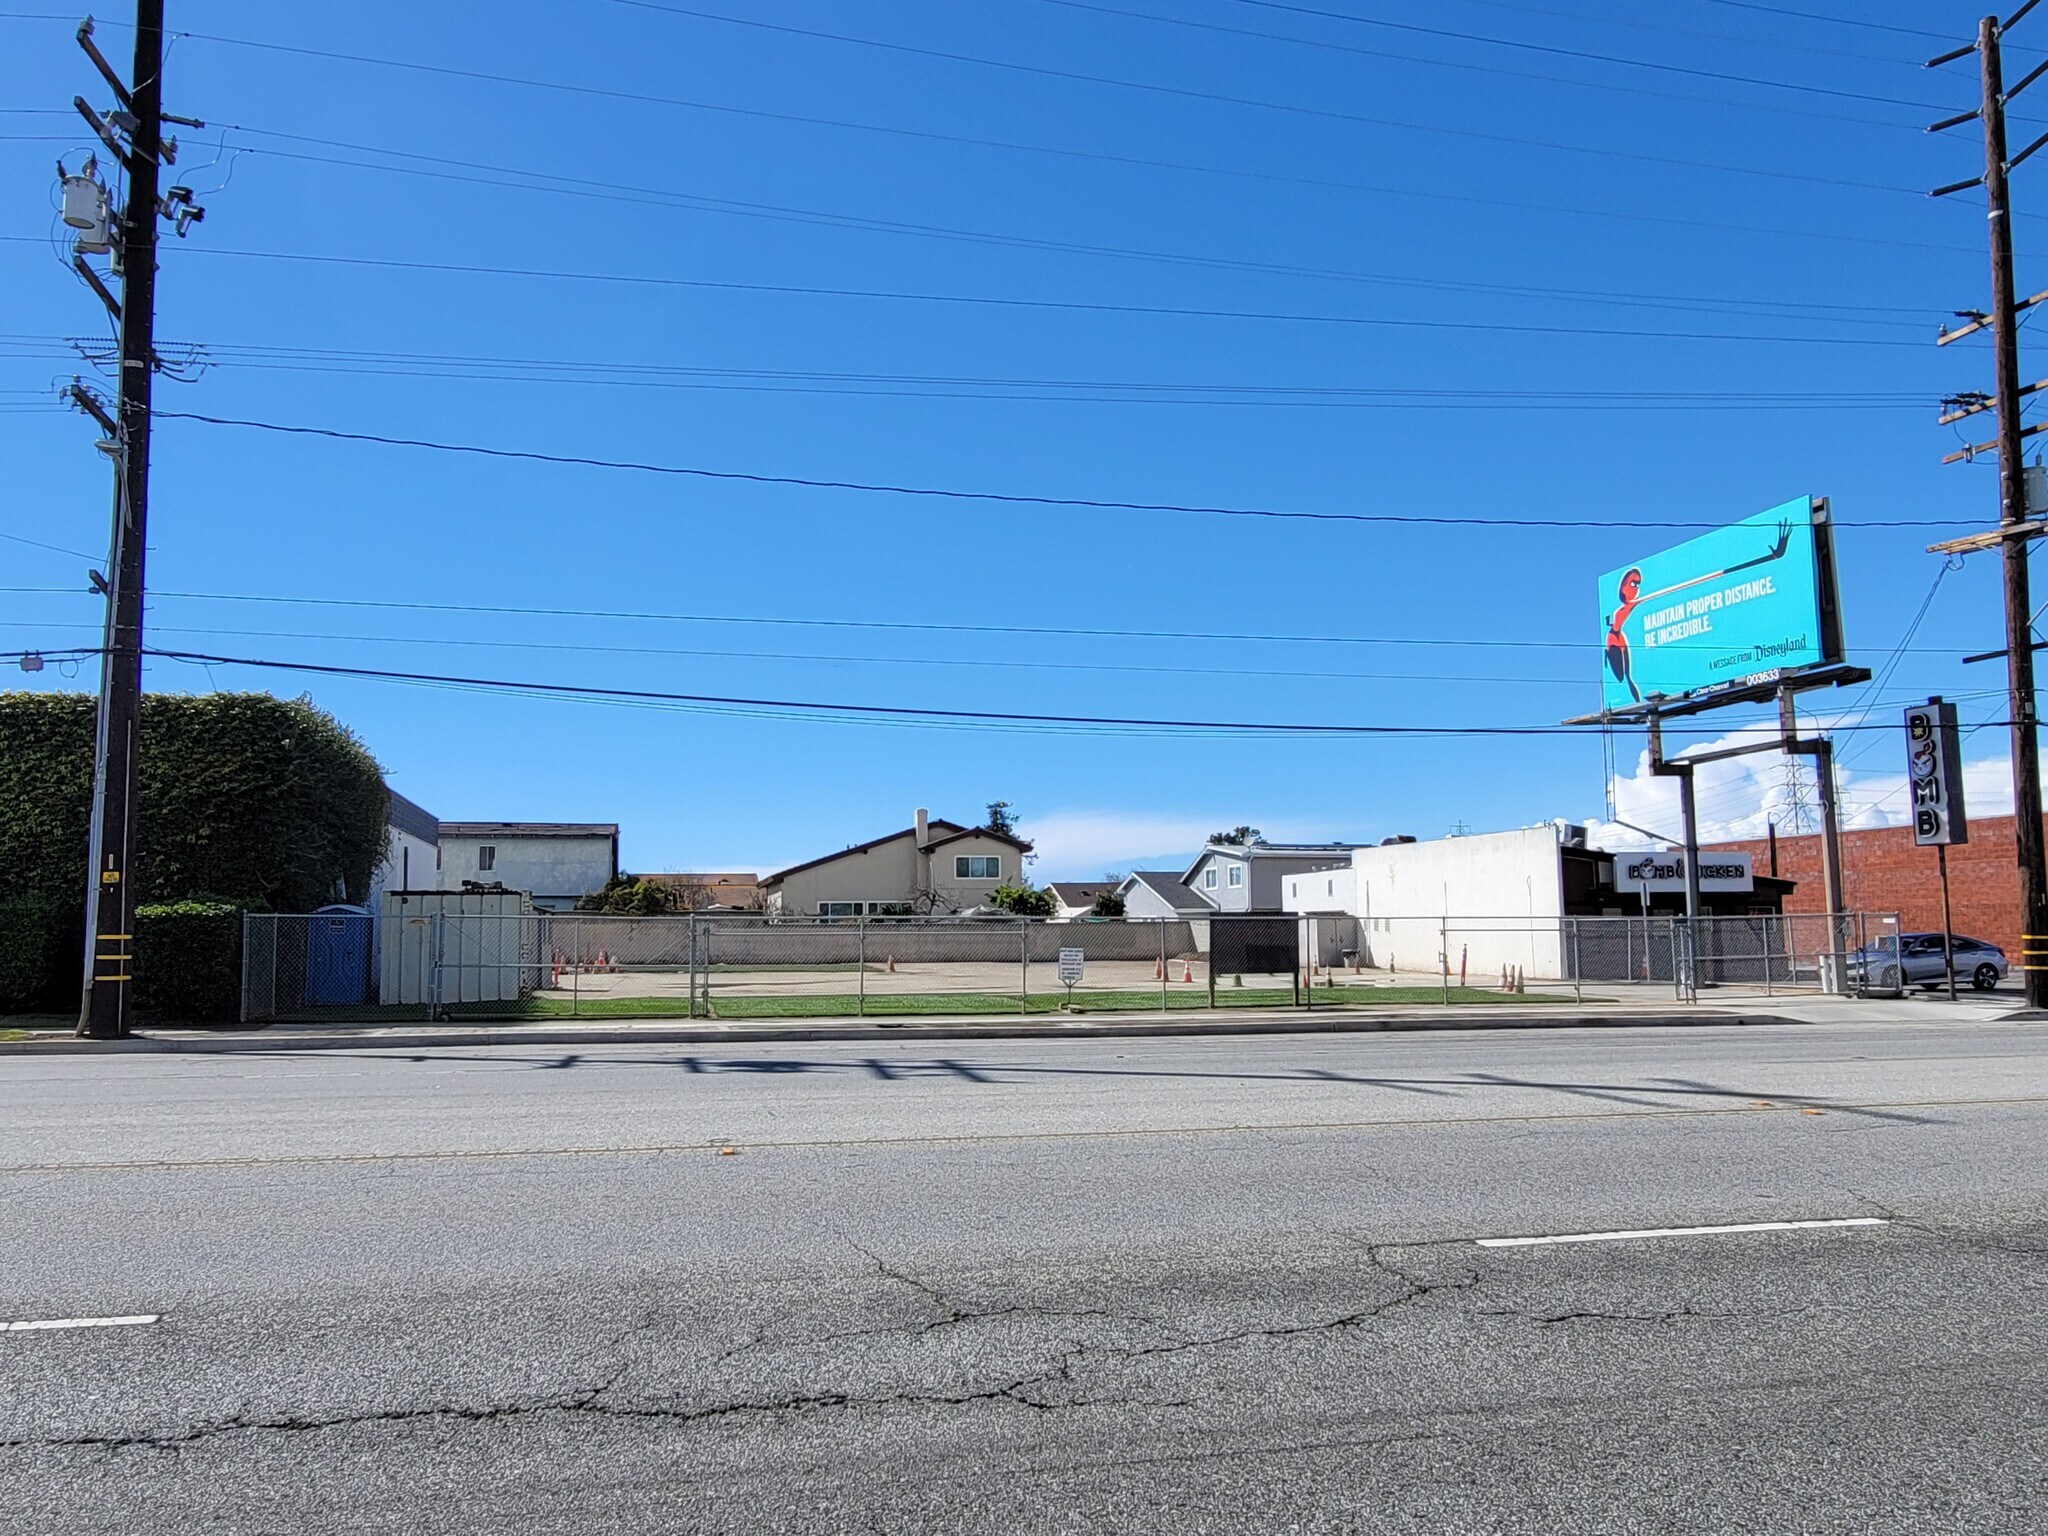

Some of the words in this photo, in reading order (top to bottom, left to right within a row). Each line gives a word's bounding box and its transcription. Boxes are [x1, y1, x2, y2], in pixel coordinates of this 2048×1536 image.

[1643, 603, 1685, 631] MAINTAIN
[1686, 592, 1723, 617] PROPER
[1724, 576, 1776, 606] DISTANCE.
[1644, 631, 1657, 647] BE
[1657, 615, 1713, 645] INCREDIBLE.
[1713, 655, 1737, 669] MESSAGE
[1737, 652, 1752, 664] FROM
[1753, 633, 1807, 662] Disneyland
[1675, 858, 1745, 879] CICKEN
